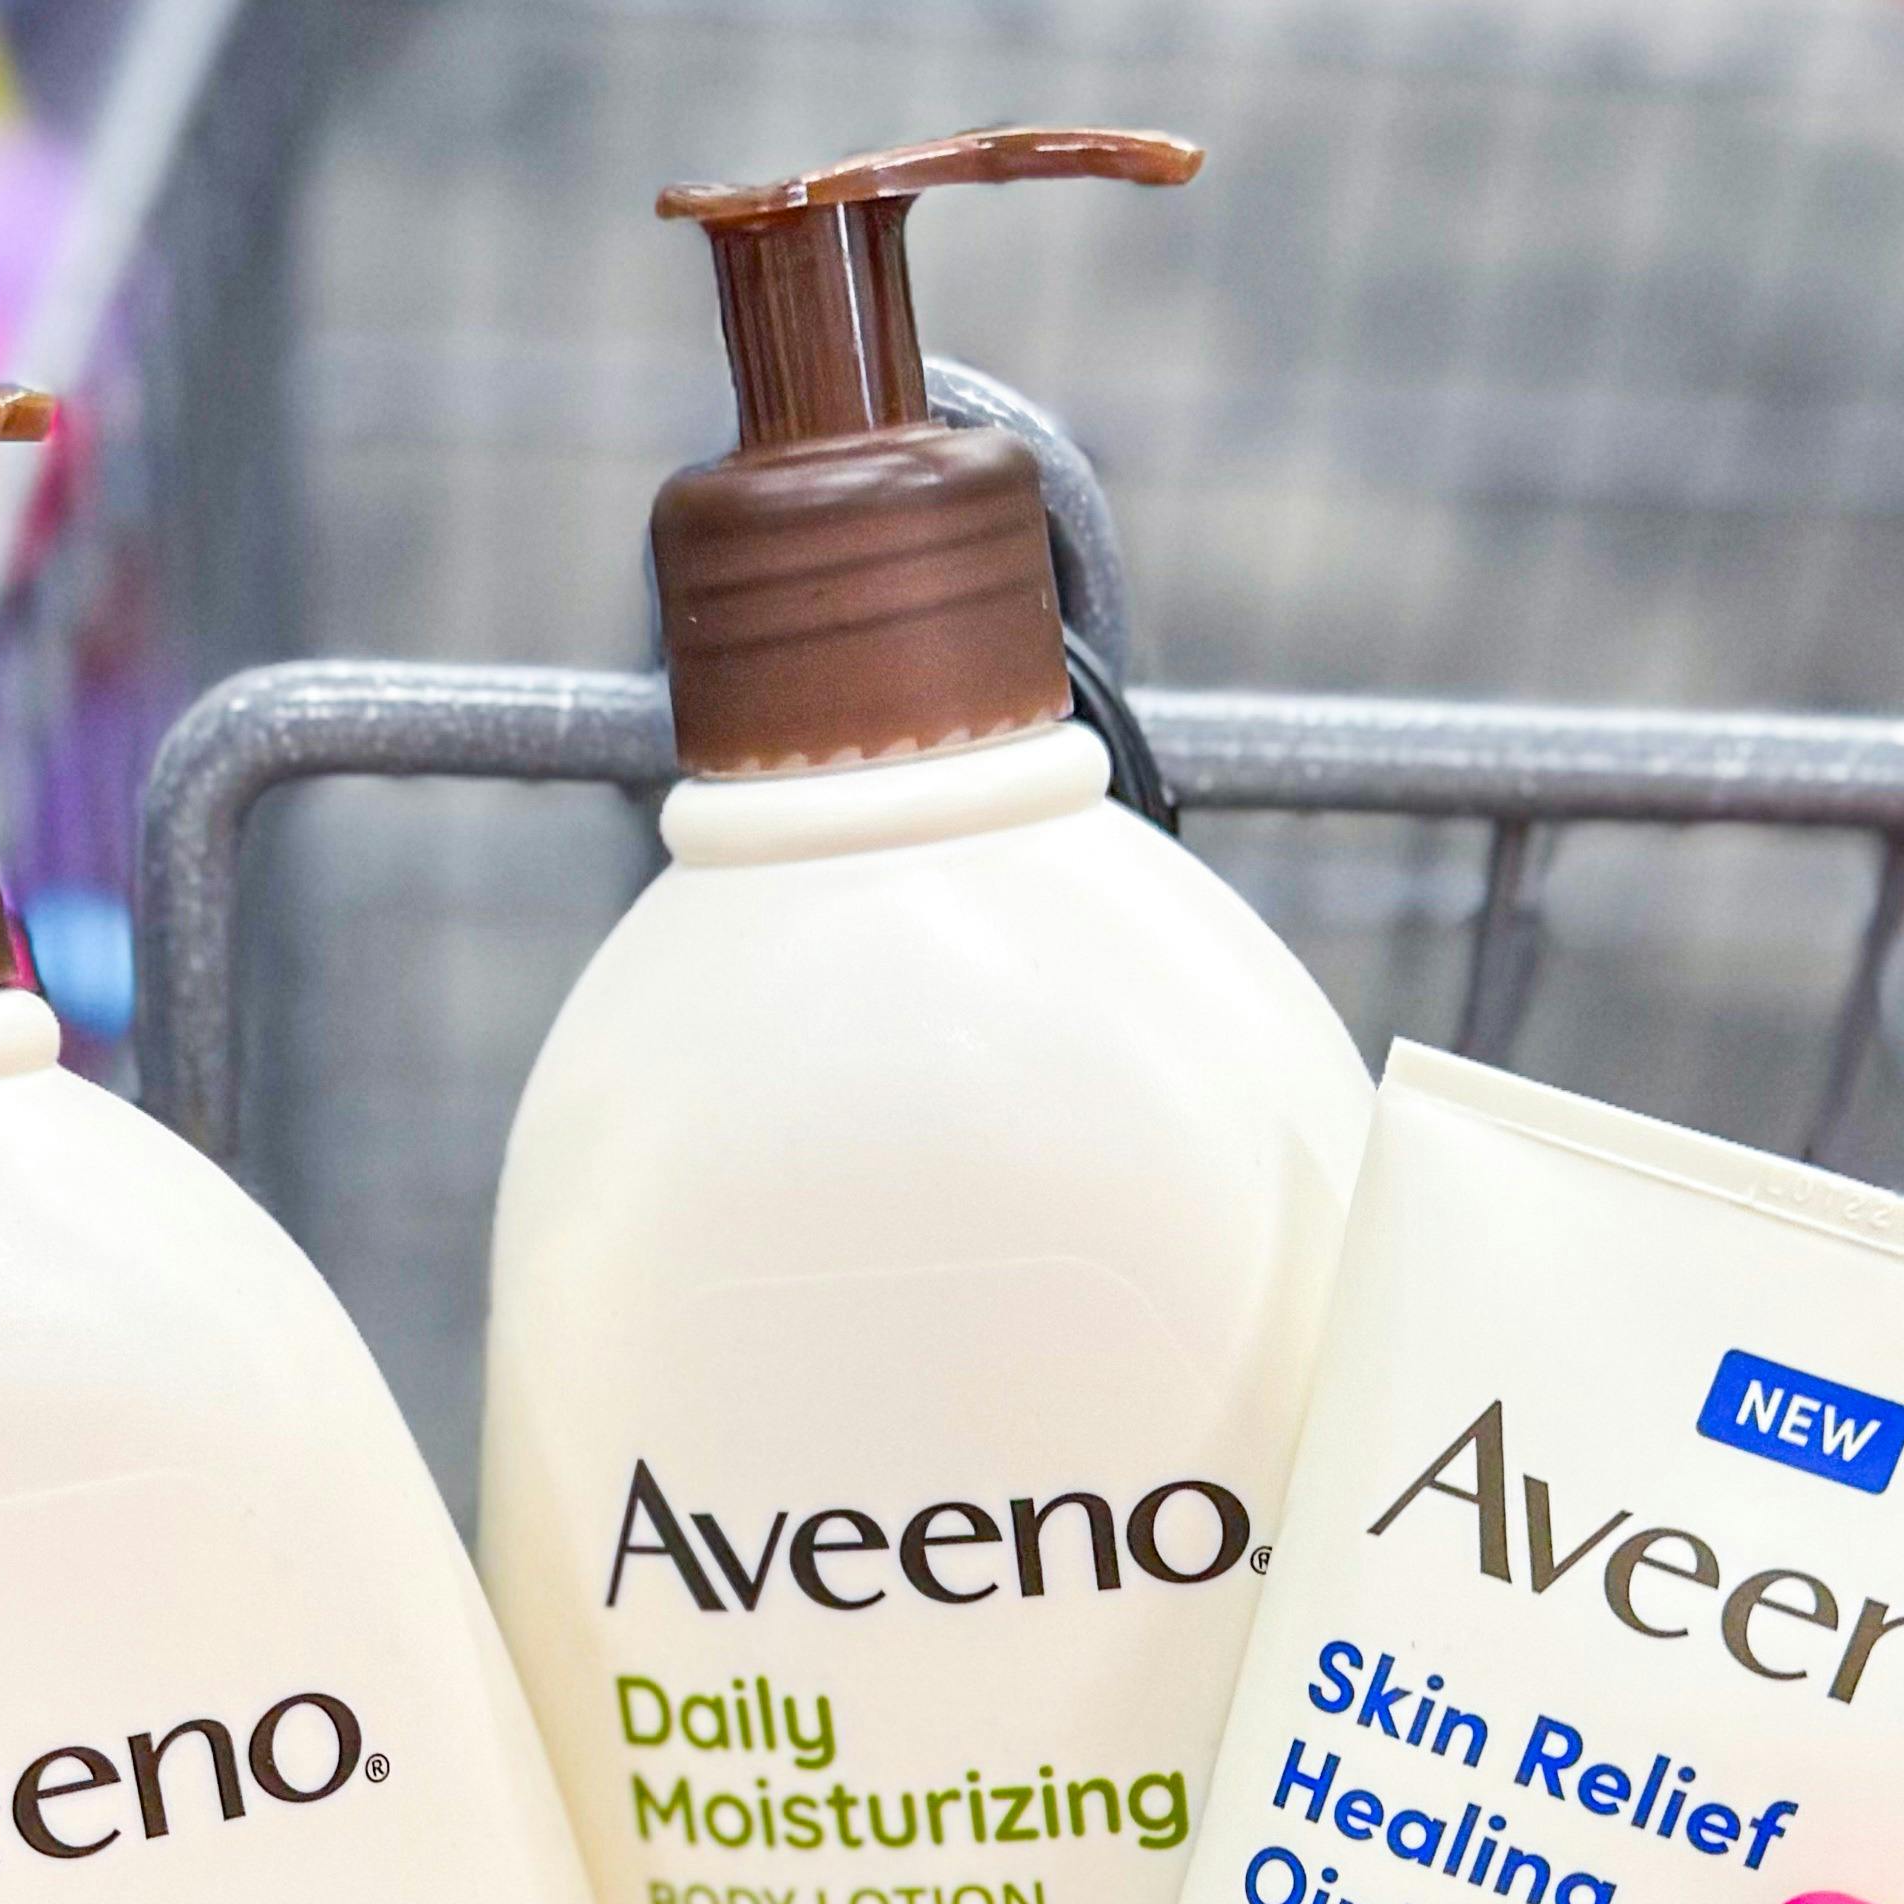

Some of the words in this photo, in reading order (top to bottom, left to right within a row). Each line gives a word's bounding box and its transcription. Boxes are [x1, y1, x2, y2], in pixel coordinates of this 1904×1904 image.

[1736, 1380, 1882, 1464] NEW
[616, 1675, 835, 1771] Daily
[1307, 1639, 1489, 1769] Skin
[1516, 1714, 1800, 1872] Relief
[631, 1765, 1189, 1849] Moisturizing
